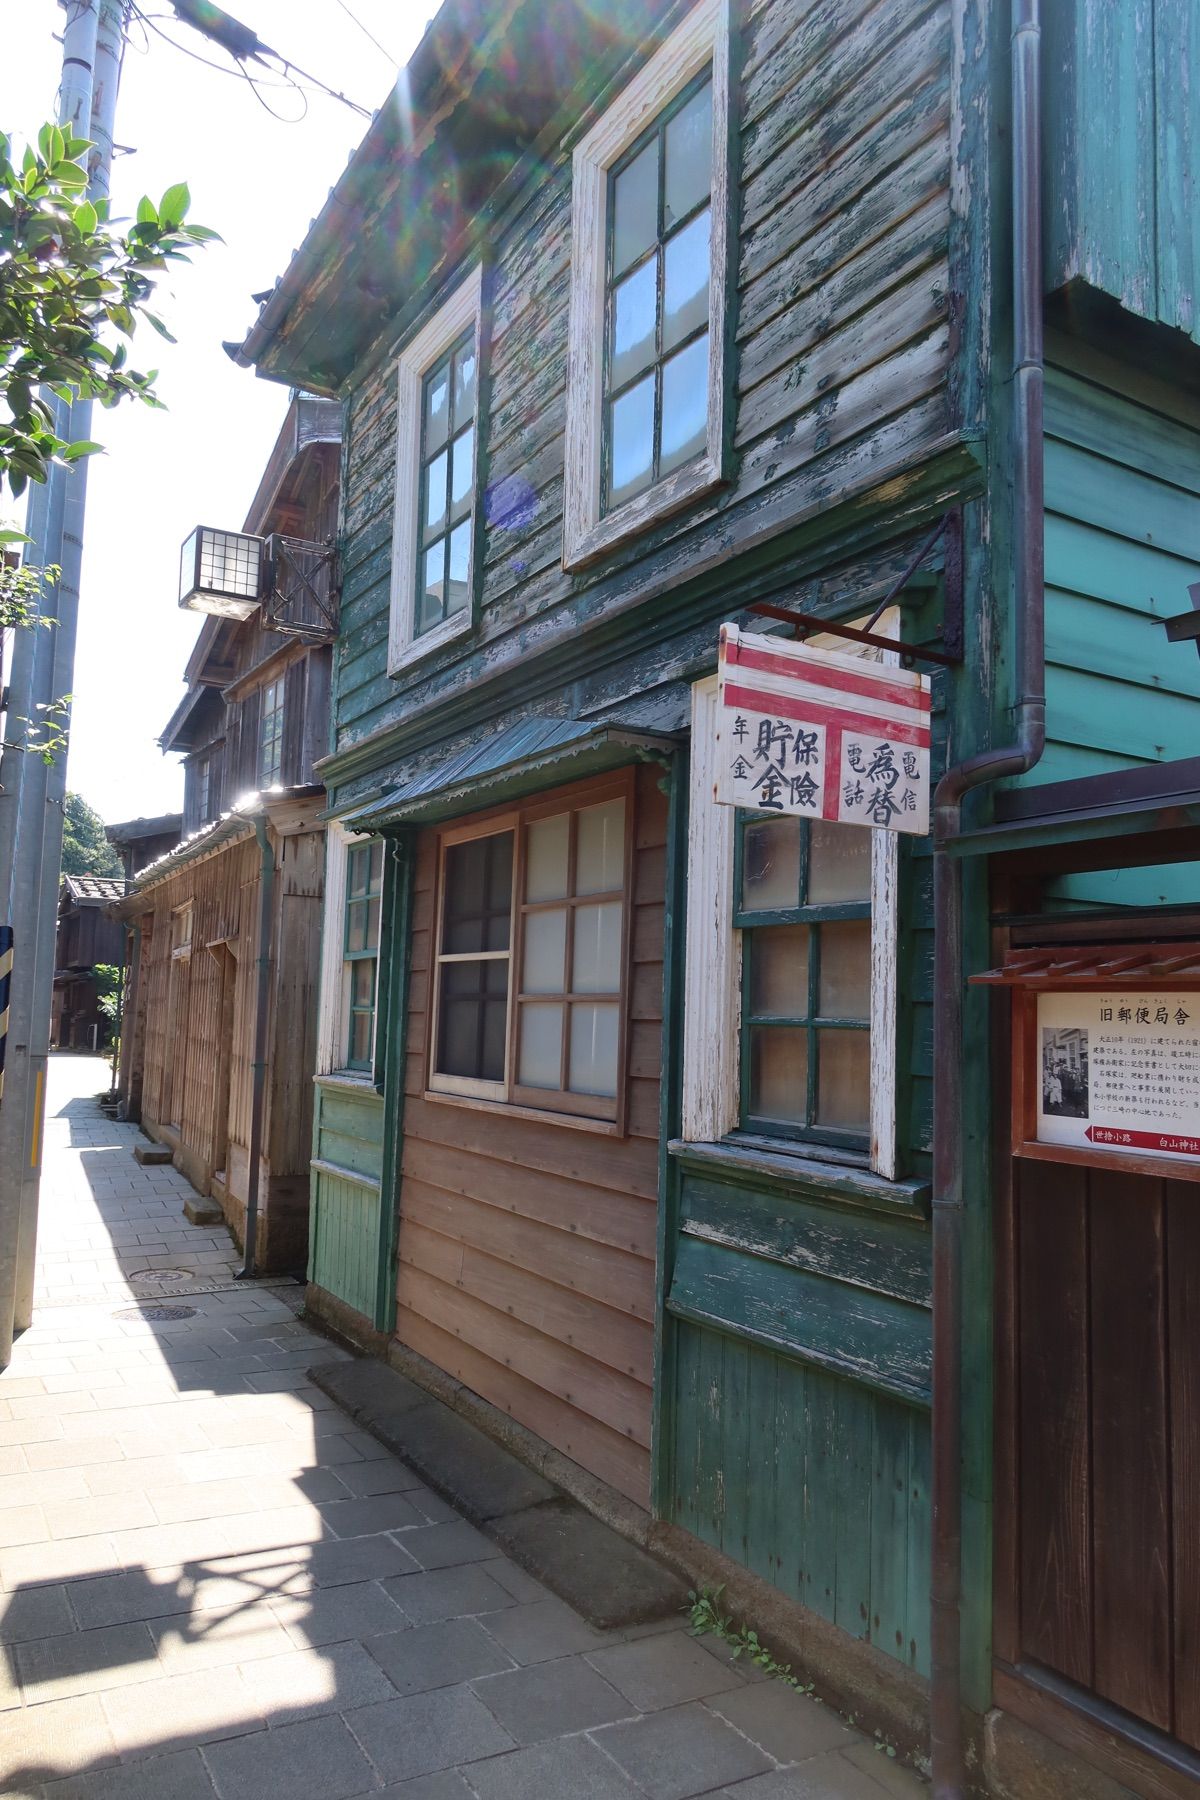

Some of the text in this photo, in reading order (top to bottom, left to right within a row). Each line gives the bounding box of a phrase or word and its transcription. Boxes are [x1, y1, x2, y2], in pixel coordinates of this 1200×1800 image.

[730, 716, 754, 779] 年金
[751, 719, 792, 809] 貯金
[842, 743, 866, 807] 電話
[901, 751, 920, 811] 電信
[1100, 1007, 1190, 1025] 旧郵便局舎
[1159, 1137, 1199, 1151] 白山神社
